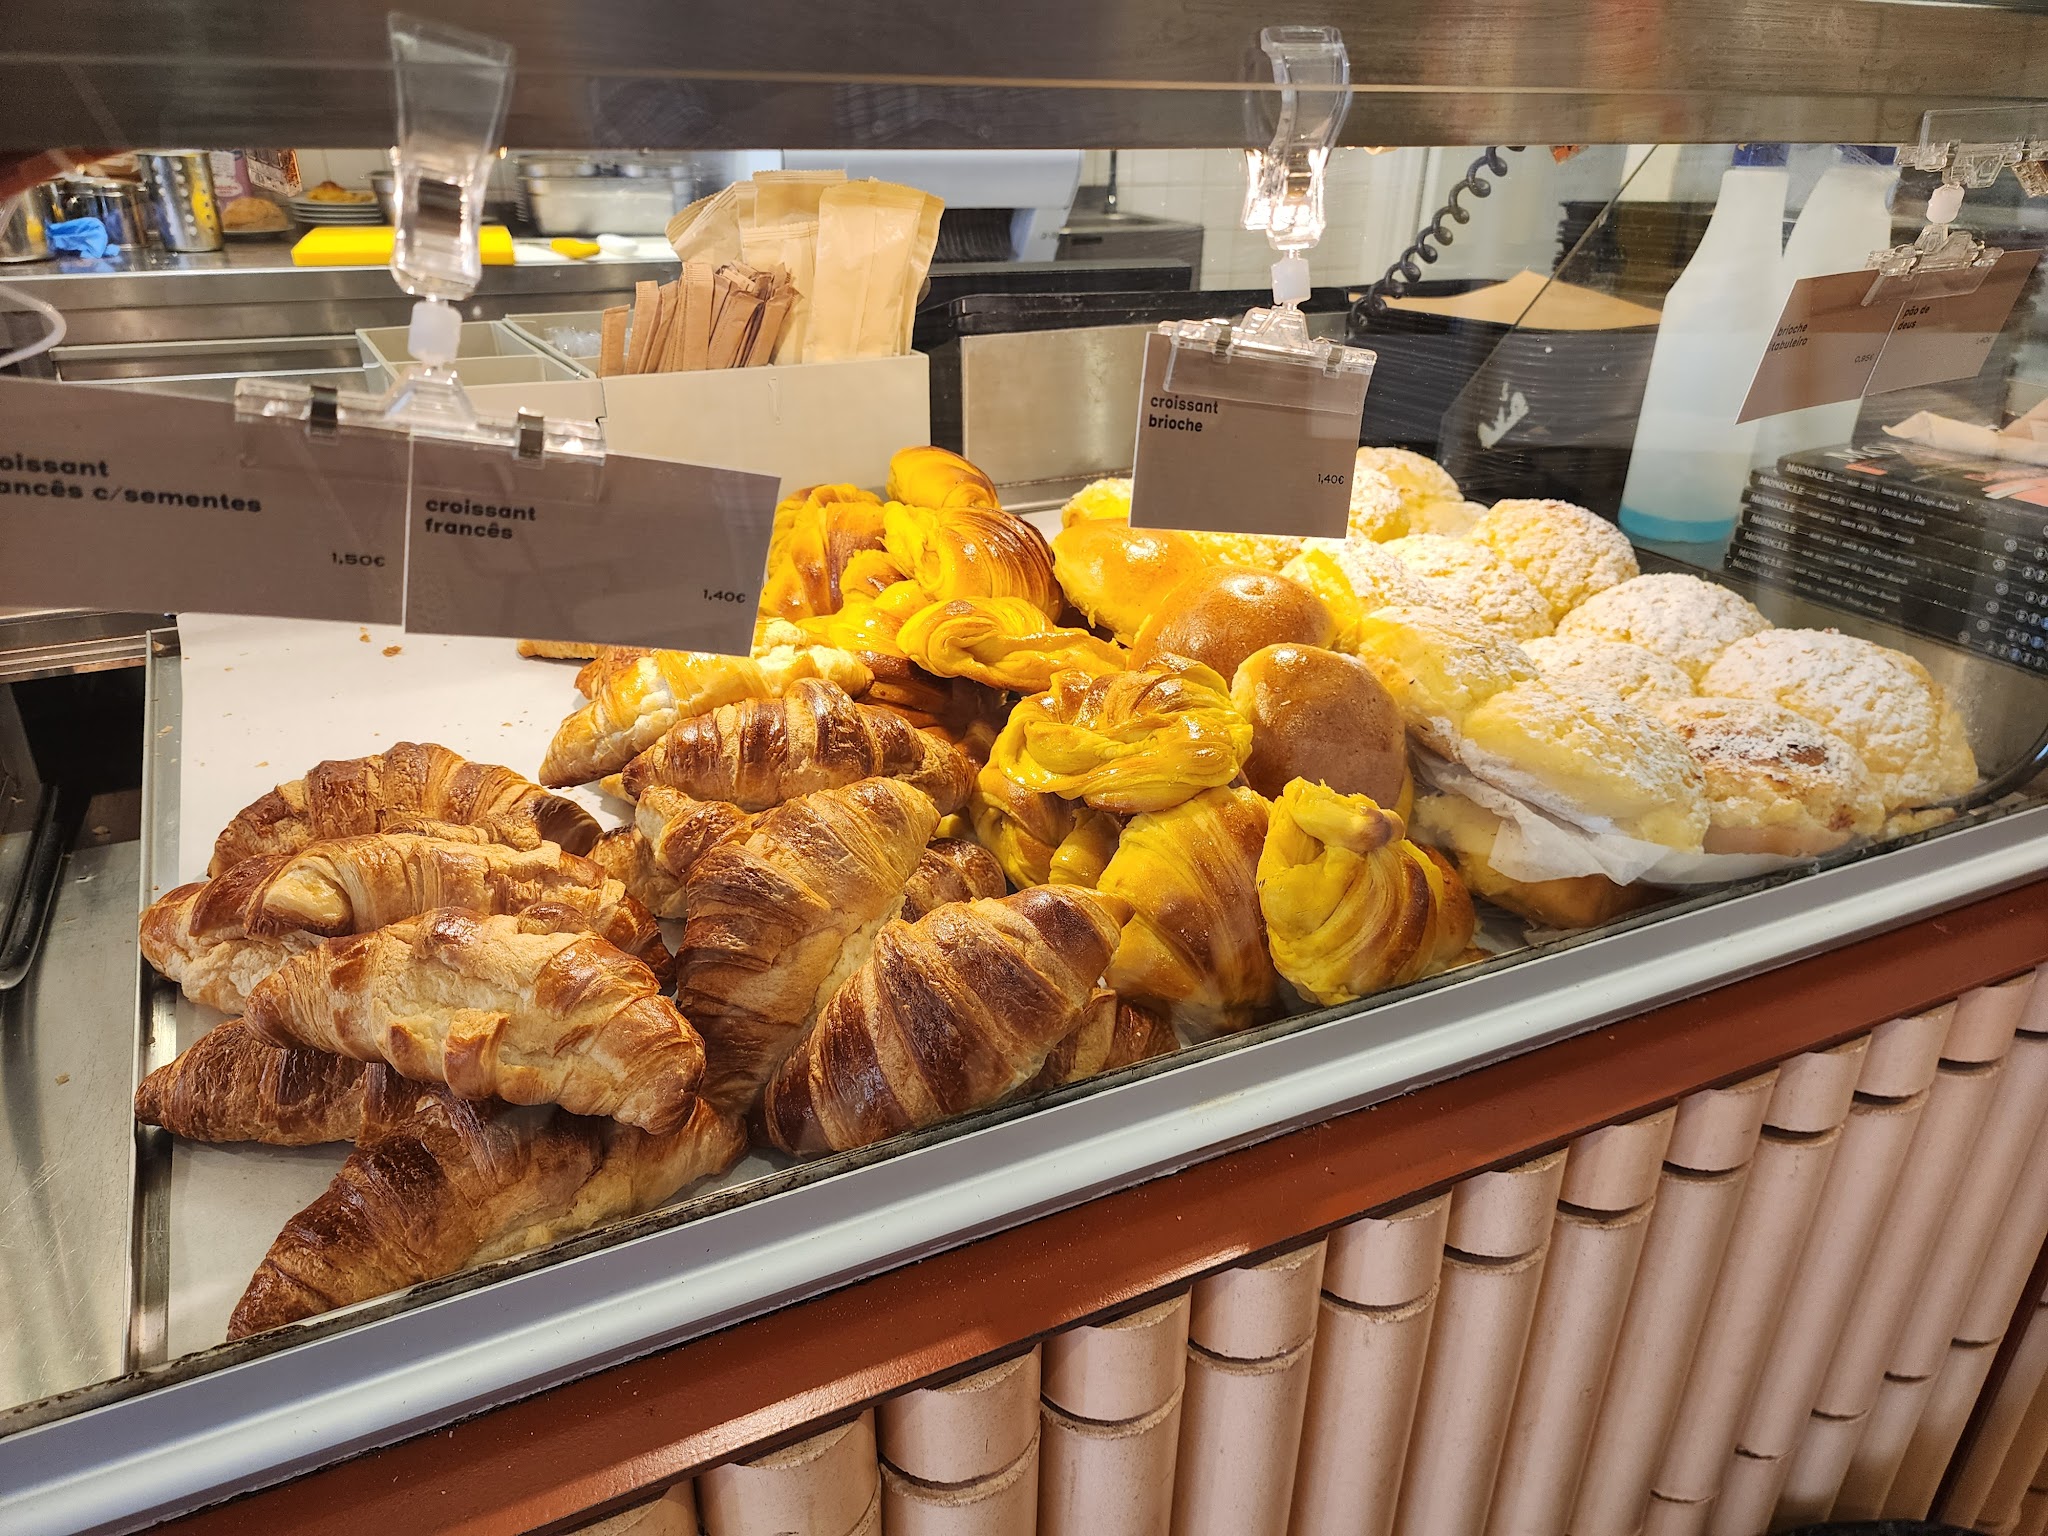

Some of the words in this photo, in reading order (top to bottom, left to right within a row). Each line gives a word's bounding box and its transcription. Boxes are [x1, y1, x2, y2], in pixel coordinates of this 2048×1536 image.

[1903, 305, 1919, 319] pão
[1919, 304, 1931, 315] de
[1777, 324, 1808, 337] brioche
[1897, 320, 1917, 331] deus
[1770, 337, 1808, 352] tabuleiro
[1150, 395, 1219, 415] croissant
[1149, 414, 1203, 433] brioche
[0, 452, 109, 477] oissant
[1785, 462, 1836, 484] MONOCLE
[1317, 473, 1345, 486] 1,40€
[1758, 475, 1806, 496] MONOCLE
[93, 487, 262, 513] c/sementes
[425, 498, 537, 522] croissant
[1750, 493, 1797, 514] MONOCLE
[425, 518, 514, 540] francês
